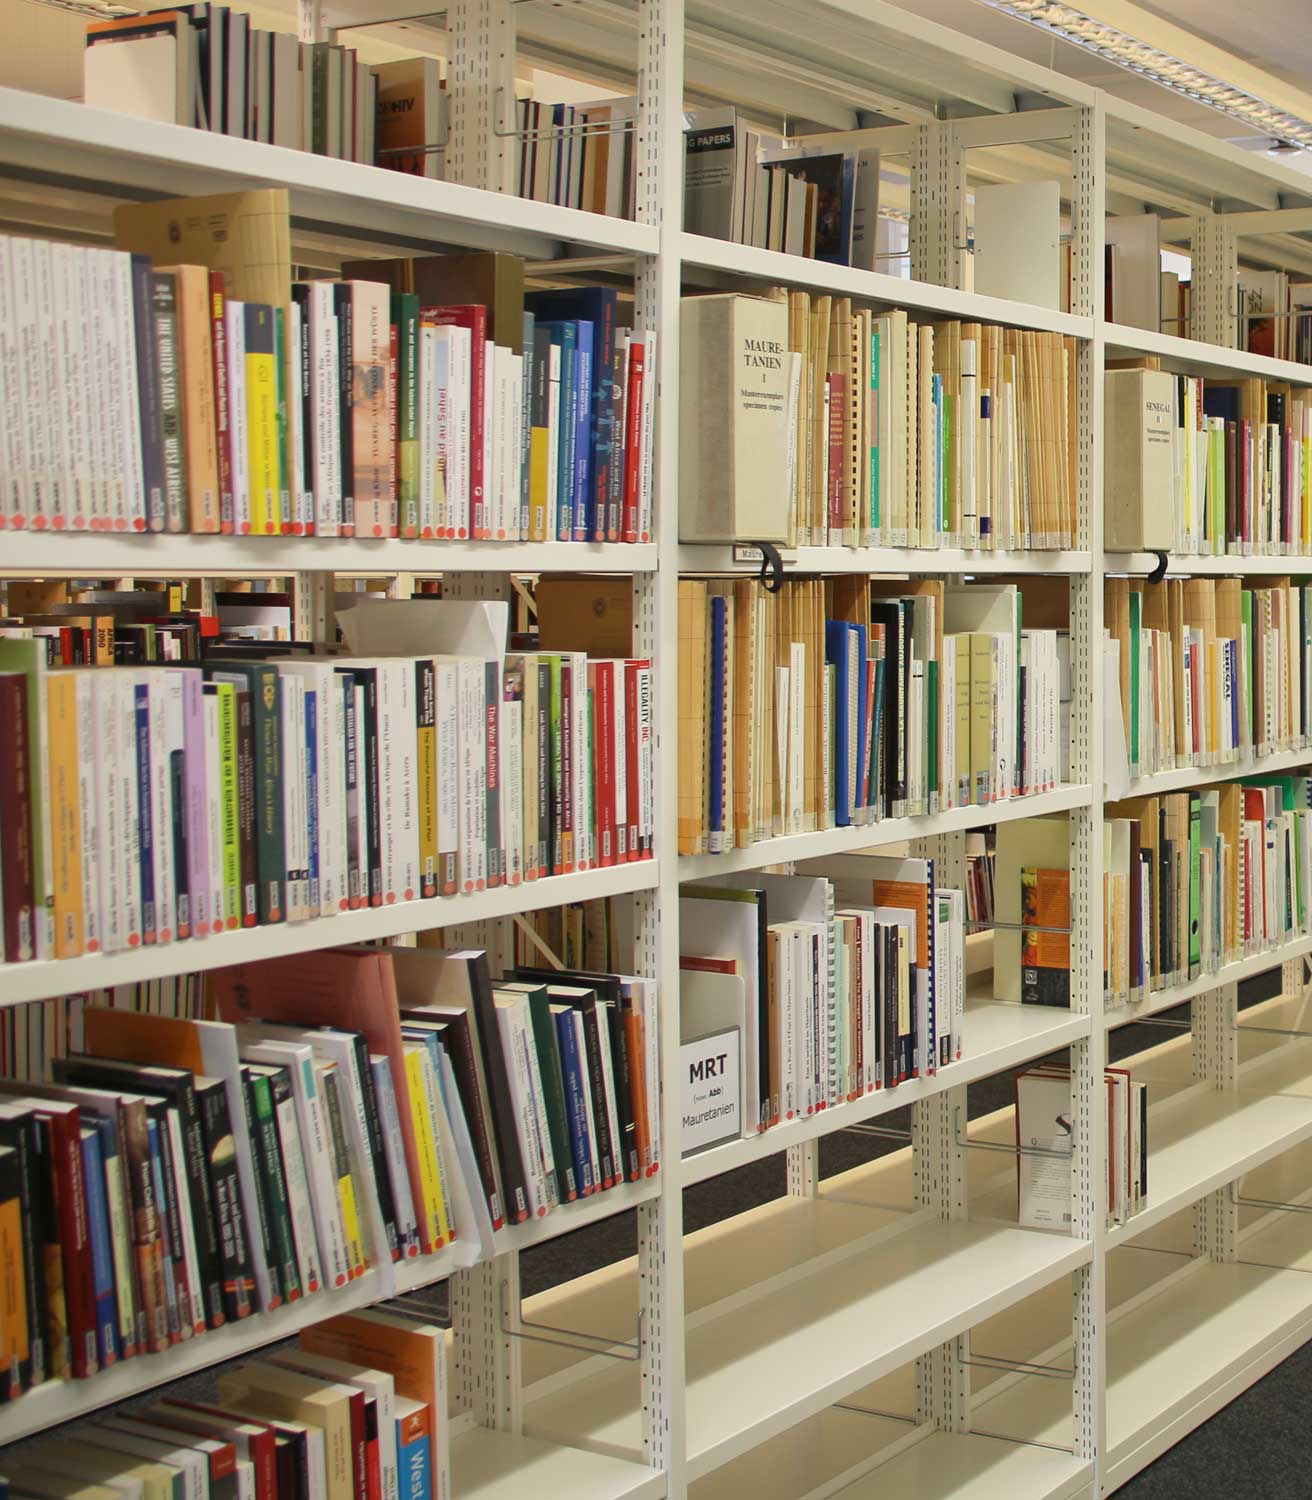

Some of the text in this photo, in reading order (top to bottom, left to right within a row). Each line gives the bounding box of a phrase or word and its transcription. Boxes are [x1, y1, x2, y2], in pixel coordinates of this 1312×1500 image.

[697, 134, 731, 146] PAPERS
[158, 319, 172, 336] THE
[302, 324, 310, 348] Security
[159, 340, 174, 373] UNITED
[744, 338, 784, 355] MAURE-
[743, 354, 782, 370] TANIEN
[160, 377, 176, 410] STATES
[326, 370, 334, 405] française
[437, 388, 446, 418] Sahel
[1146, 401, 1170, 413] SENEGAL
[163, 414, 176, 434] AND
[440, 426, 446, 439] au
[165, 439, 178, 463] WEST
[327, 455, 335, 482] Afrique
[641, 675, 649, 743] ILLEGALITY, INC.
[347, 708, 355, 737] NOSTALGIA
[488, 707, 496, 788] The War Machines
[404, 819, 411, 830] De
[690, 1053, 728, 1084] MRT
[682, 1103, 735, 1128] Mauretanien
[410, 1450, 424, 1499] West
